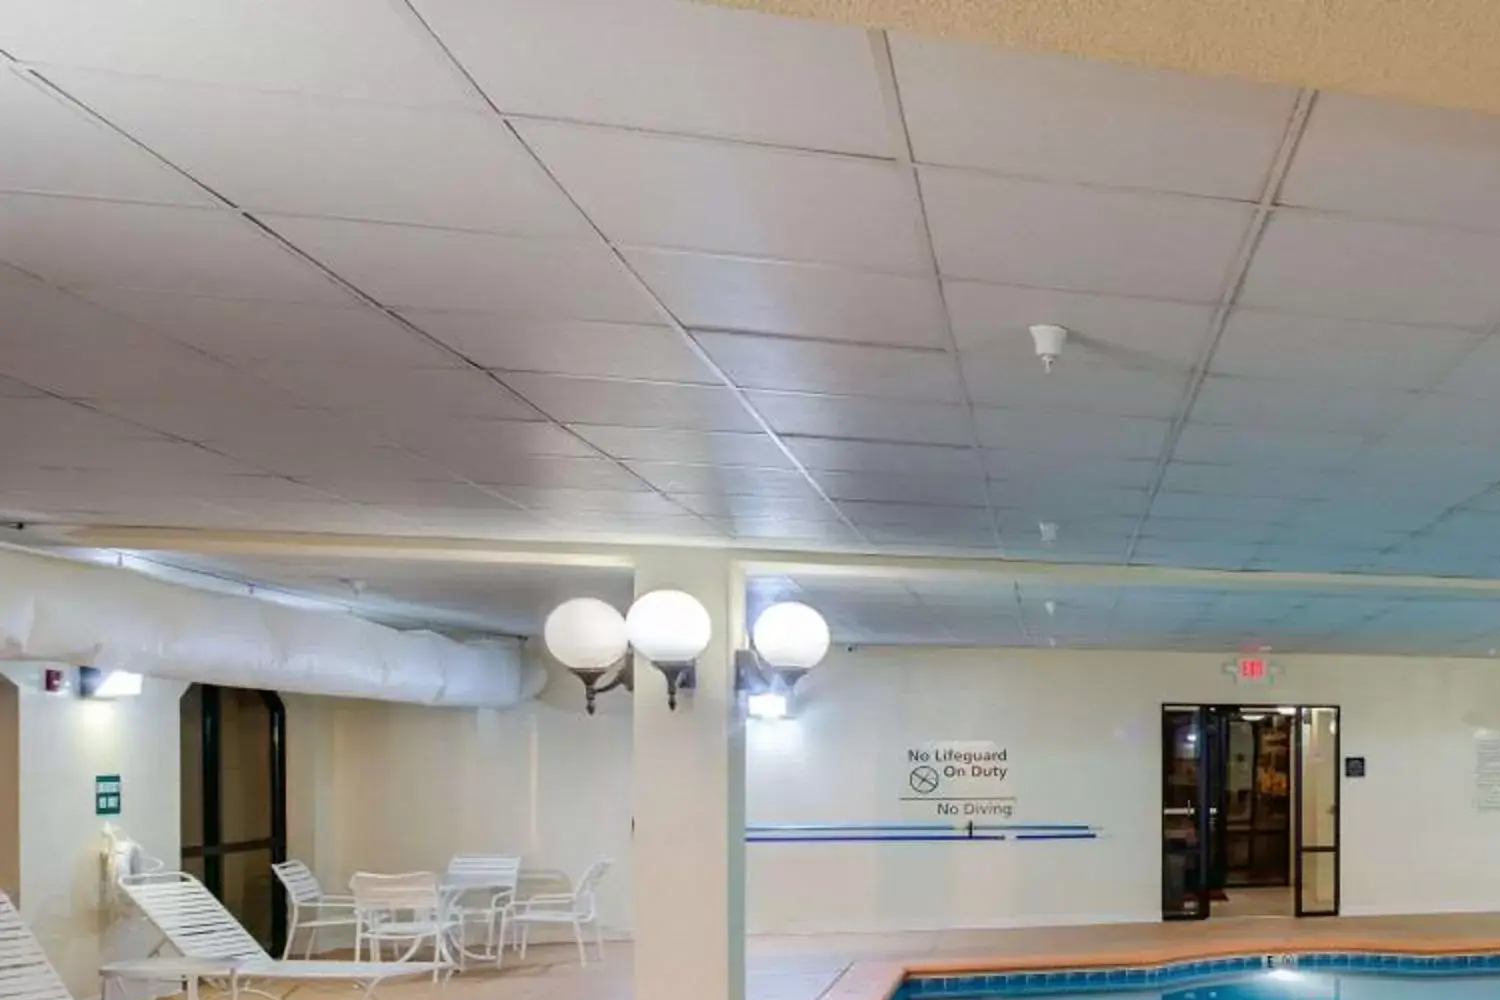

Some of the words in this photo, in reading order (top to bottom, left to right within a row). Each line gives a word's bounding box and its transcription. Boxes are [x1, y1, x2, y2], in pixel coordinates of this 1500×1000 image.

[908, 749, 929, 761] No
[935, 748, 1007, 764] Lifeguard
[943, 765, 965, 778] On
[971, 765, 1007, 781] Duty
[937, 803, 959, 815] No
[963, 803, 1013, 818] Diving
